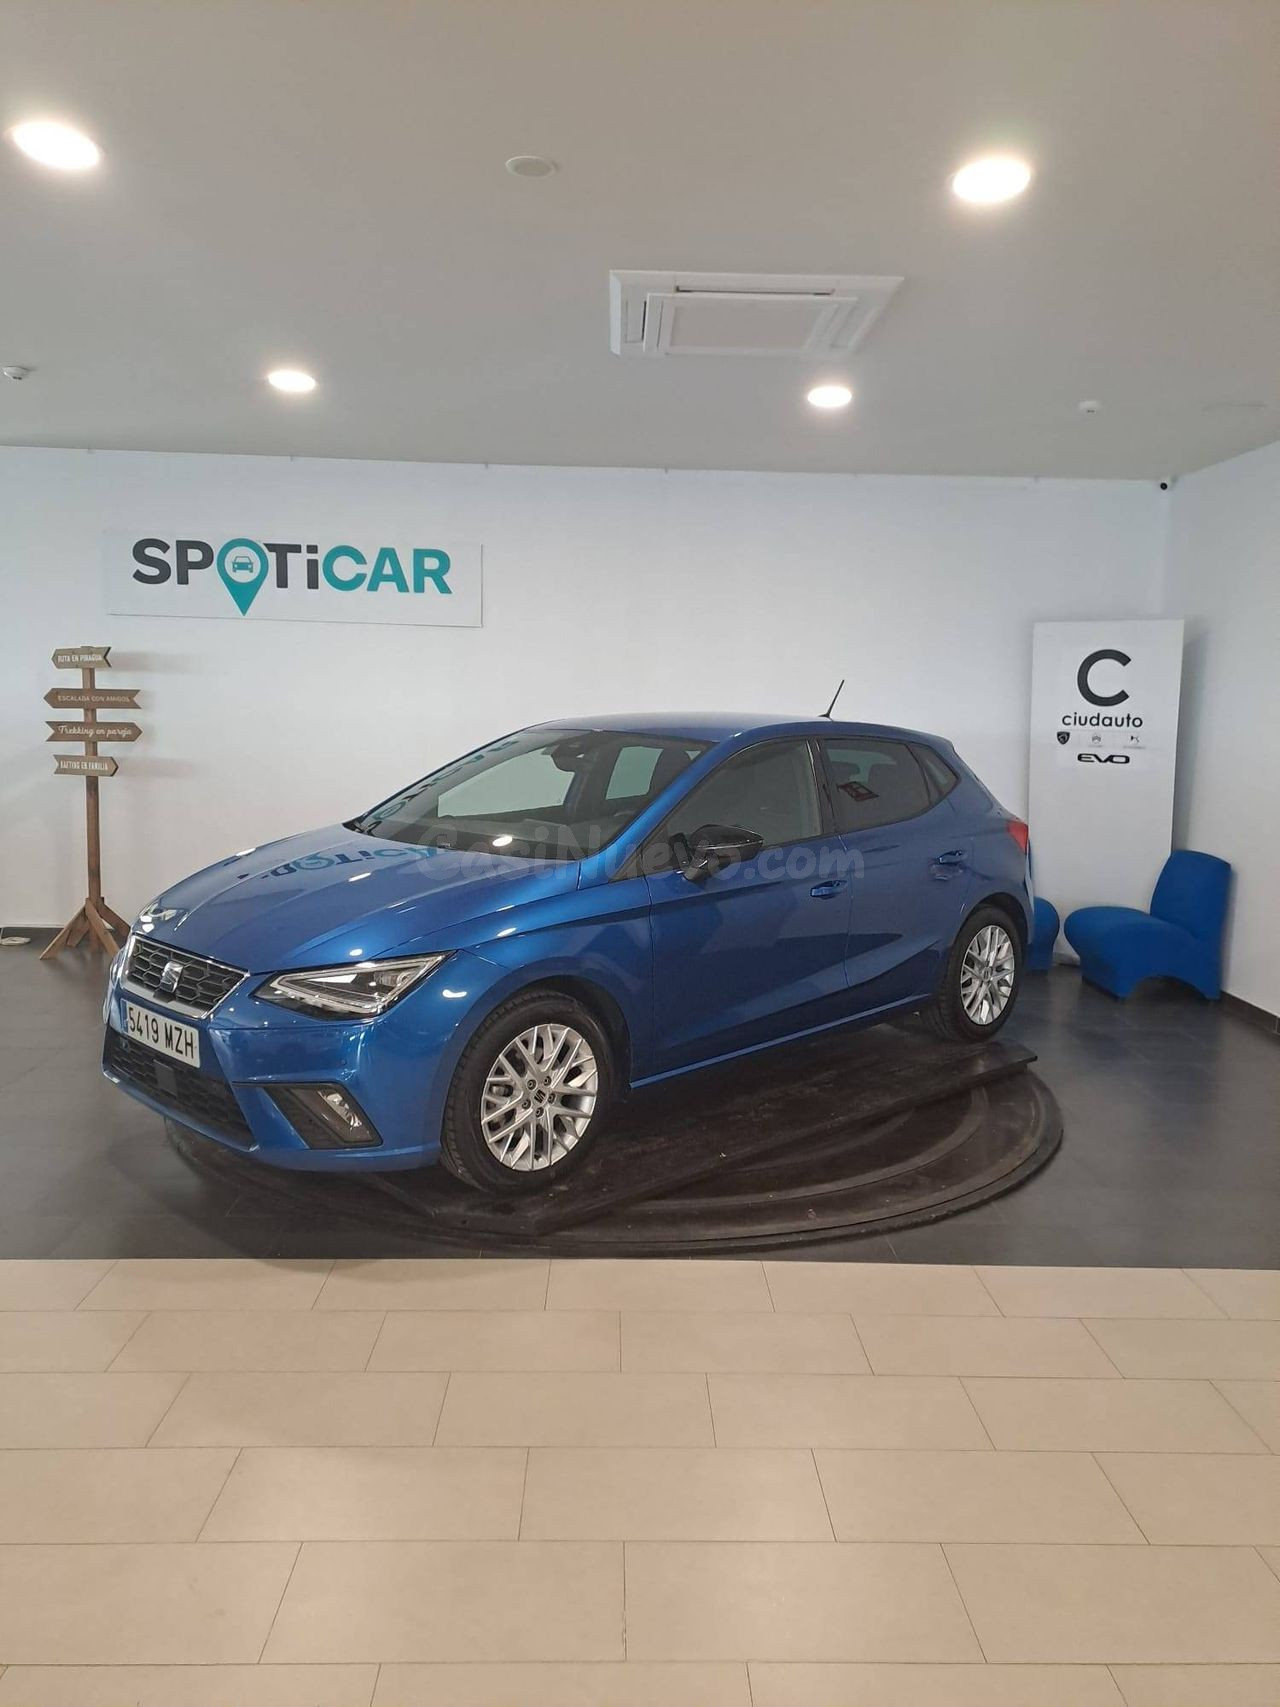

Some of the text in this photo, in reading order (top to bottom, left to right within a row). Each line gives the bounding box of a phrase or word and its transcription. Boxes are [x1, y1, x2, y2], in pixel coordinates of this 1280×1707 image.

[1061, 711, 1144, 728] ciudauto
[58, 724, 95, 738] Trekking
[106, 727, 133, 739] pareja
[1077, 753, 1131, 764] EVO
[128, 1007, 195, 1060] 5419 MZH
